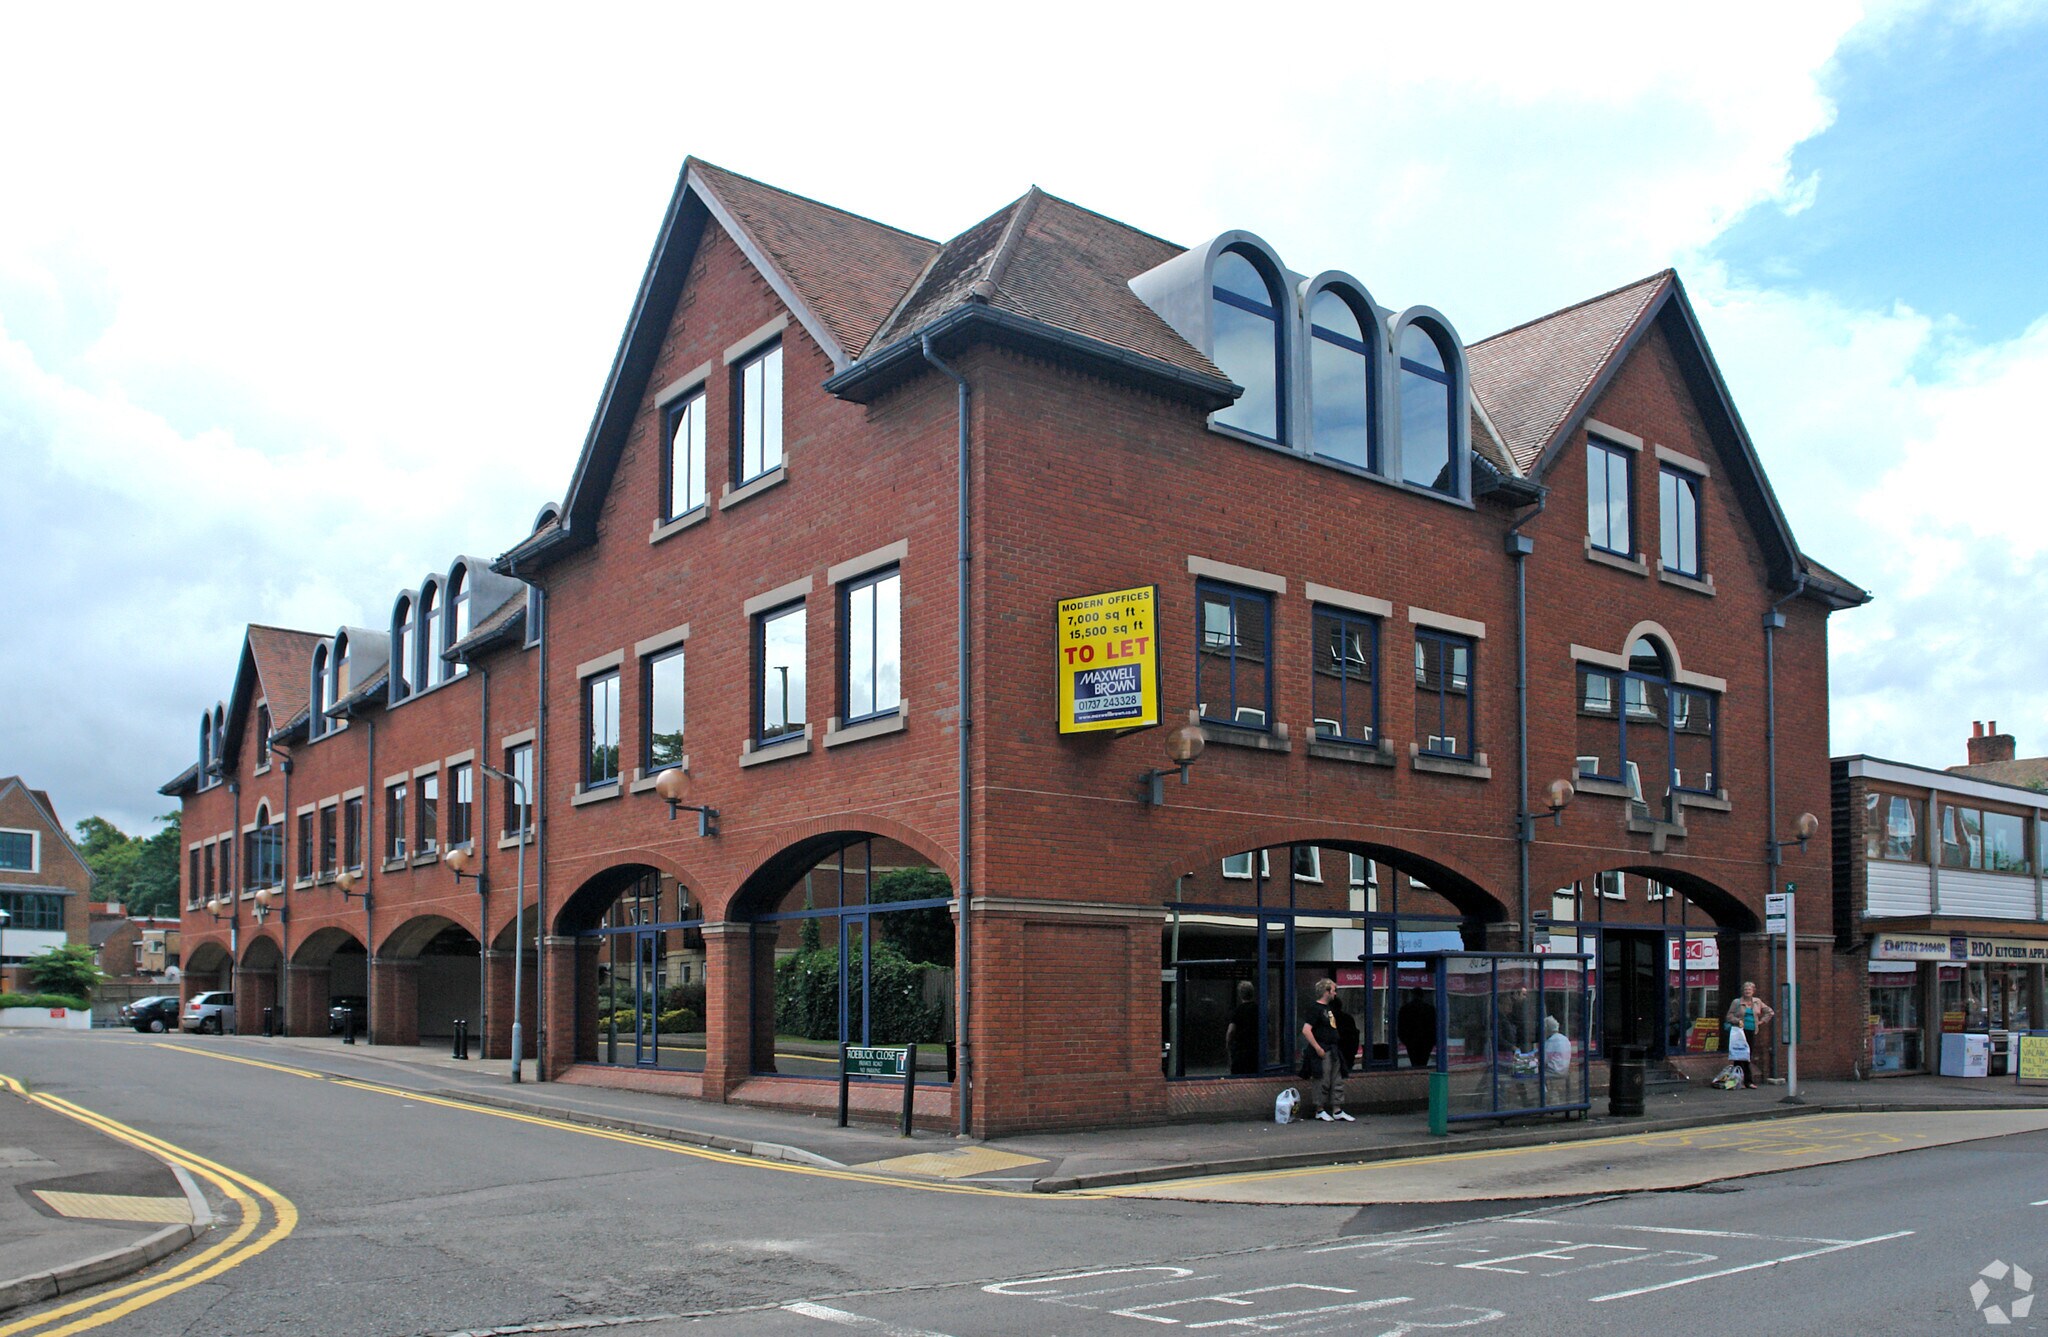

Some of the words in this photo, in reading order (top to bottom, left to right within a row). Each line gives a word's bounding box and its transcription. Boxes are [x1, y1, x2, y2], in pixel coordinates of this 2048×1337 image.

[1062, 598, 1103, 612] MODERN
[1107, 591, 1150, 605] OFFICES
[1068, 612, 1099, 627] 7,000
[1105, 611, 1120, 621] sq
[1125, 606, 1135, 617] ft
[1069, 625, 1107, 640] 15,500
[1113, 624, 1128, 634] sq
[1133, 620, 1143, 630] ft
[1064, 645, 1095, 665] TO
[1107, 637, 1149, 660] LET
[1079, 667, 1135, 685] MAXWELL
[1094, 679, 1136, 696] BROWN
[1078, 700, 1100, 711] 01737
[1103, 696, 1137, 708] 243328
[1971, 941, 1993, 957] RDO
[1995, 946, 2027, 958] KITCHEN
[847, 1049, 874, 1059] ROEBUCK
[876, 1050, 895, 1060] CLOSE
